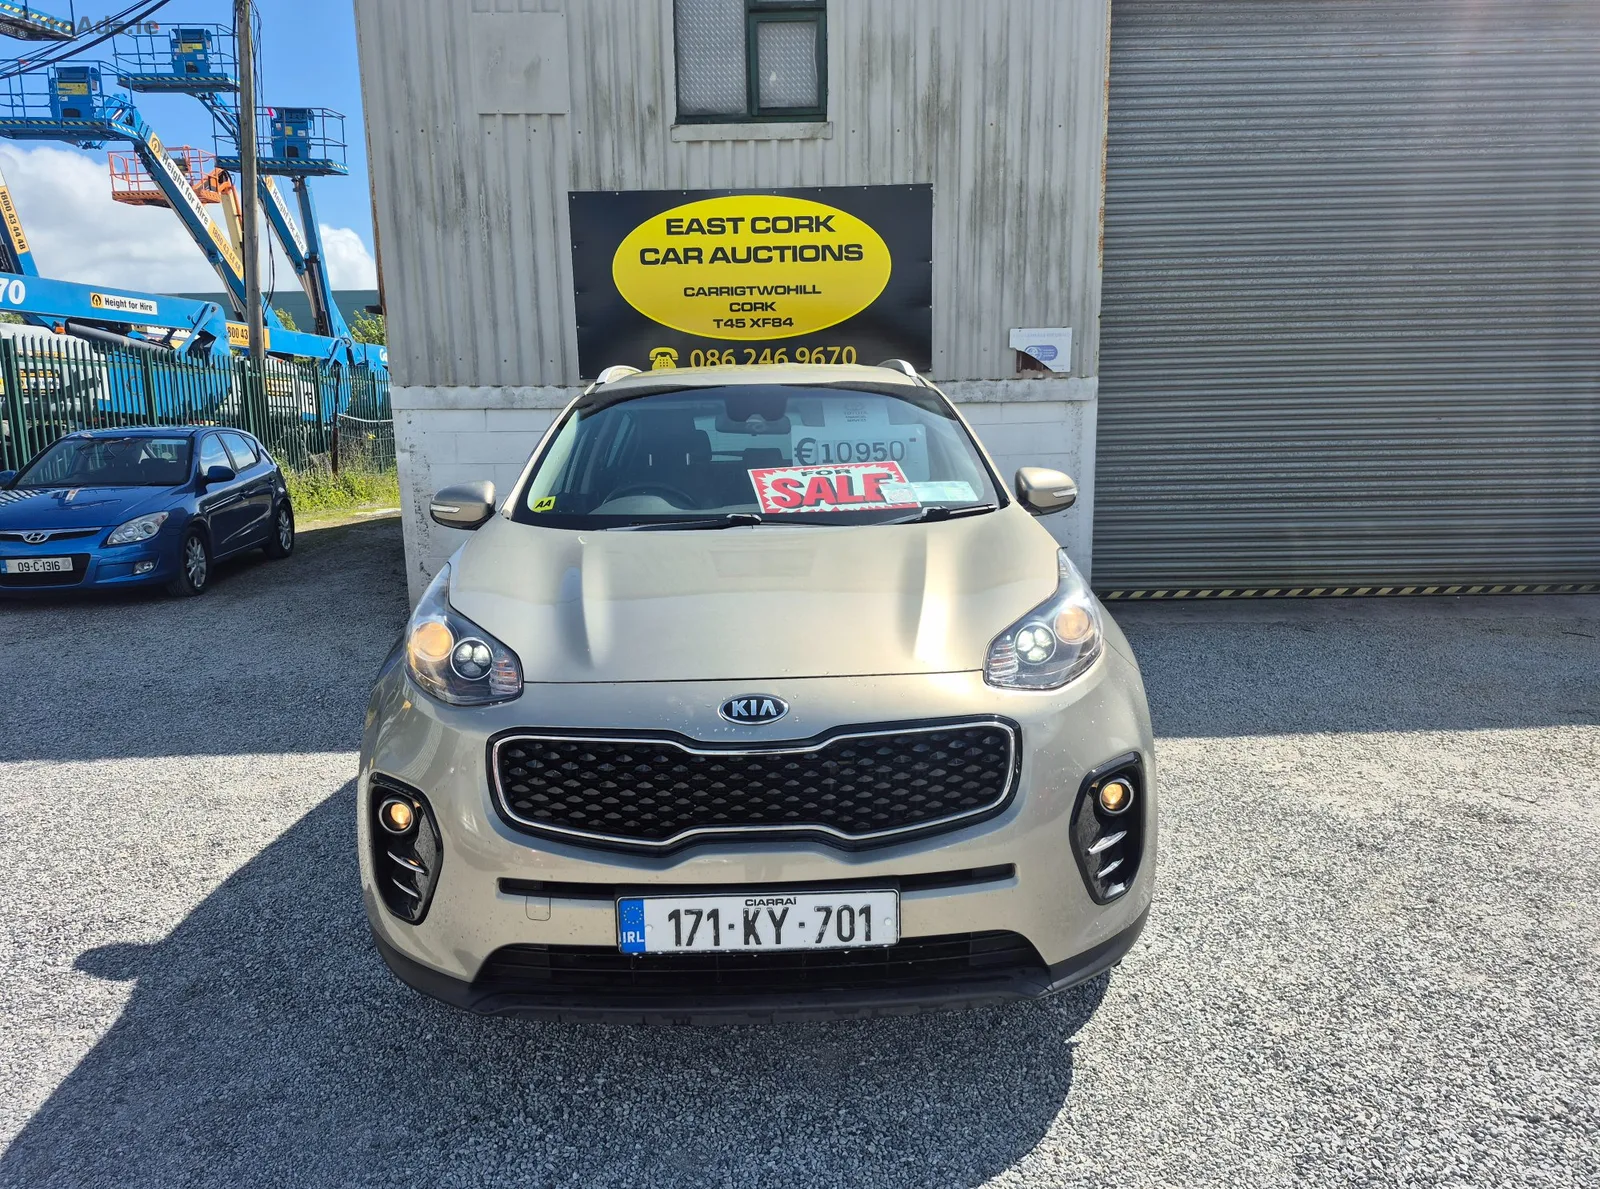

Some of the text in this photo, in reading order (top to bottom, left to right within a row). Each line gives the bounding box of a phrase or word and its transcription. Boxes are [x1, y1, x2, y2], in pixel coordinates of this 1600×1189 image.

[162, 153, 210, 225] Height for Hire
[272, 189, 288, 218] Height
[0, 190, 26, 251] 1800 43 44 48
[666, 215, 837, 235] EAST CORK
[640, 244, 864, 265] CAR AUCTIONS
[683, 285, 822, 297] CARRIGTWOHILL
[104, 297, 153, 311] Height for Hire
[729, 302, 777, 313] CORK
[713, 317, 794, 329] T45 XF84
[690, 346, 857, 368] 086 246 9670
[801, 468, 851, 477] FOR
[770, 473, 894, 509] SALE
[535, 499, 552, 509] AA
[17, 560, 61, 572] 09-C-1316
[731, 699, 777, 717] KIA
[622, 931, 645, 943] IRL
